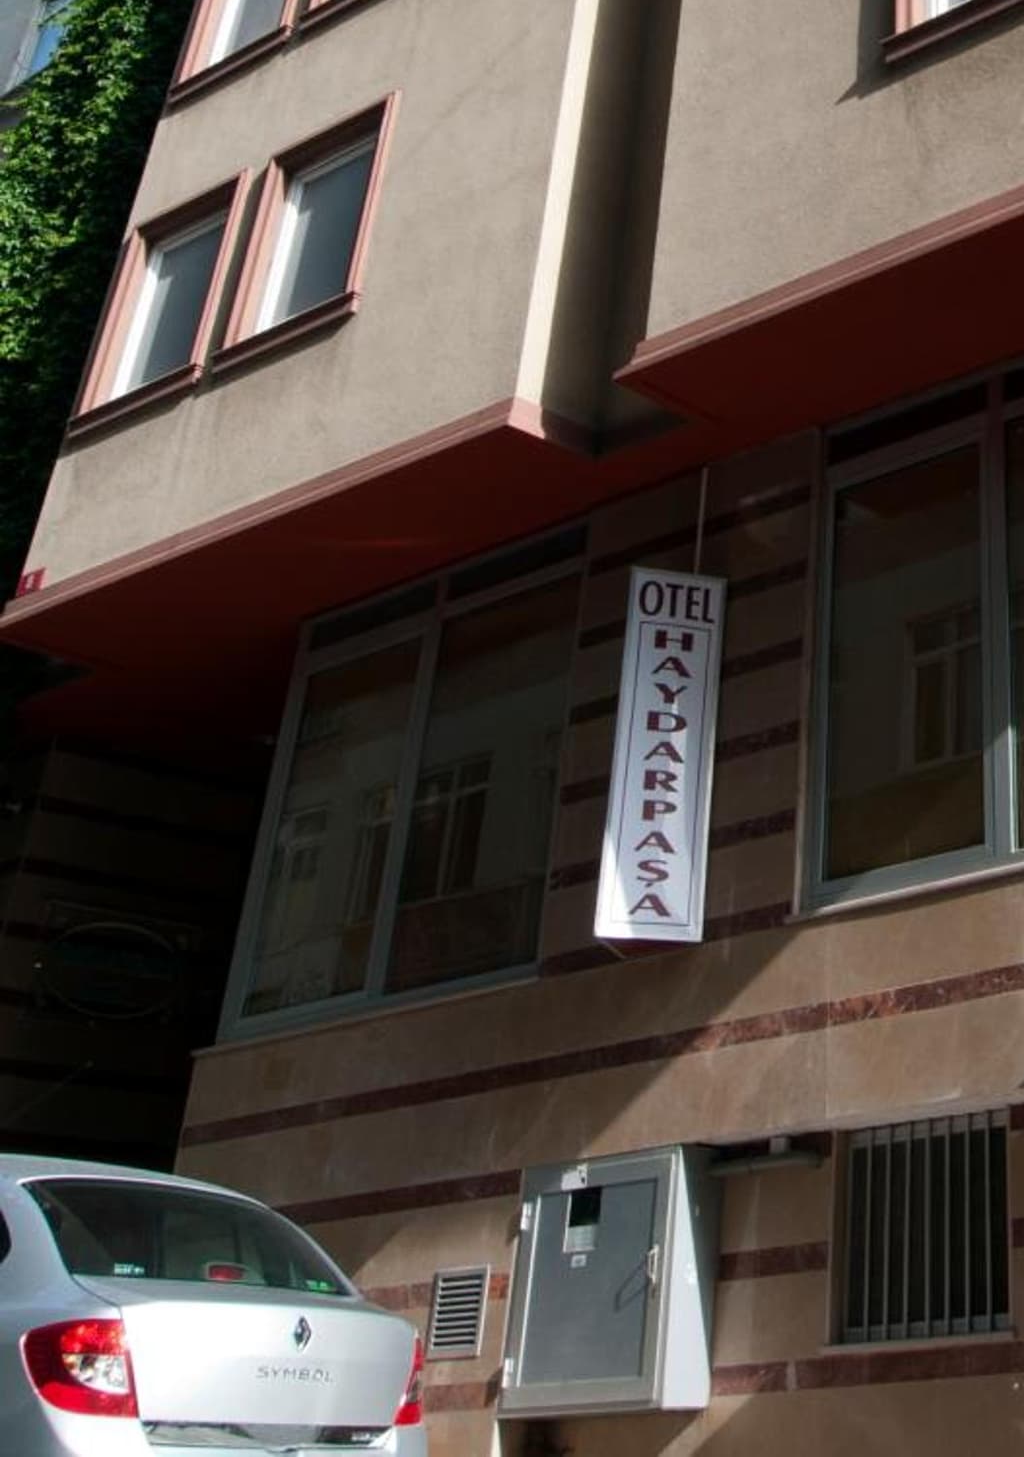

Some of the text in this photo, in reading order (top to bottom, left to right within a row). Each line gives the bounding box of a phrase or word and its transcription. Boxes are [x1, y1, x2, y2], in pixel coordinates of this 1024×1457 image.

[639, 580, 714, 623] OTEL
[629, 630, 693, 917] HAYDARPAŞA
[255, 1365, 334, 1383] SYMBOL
